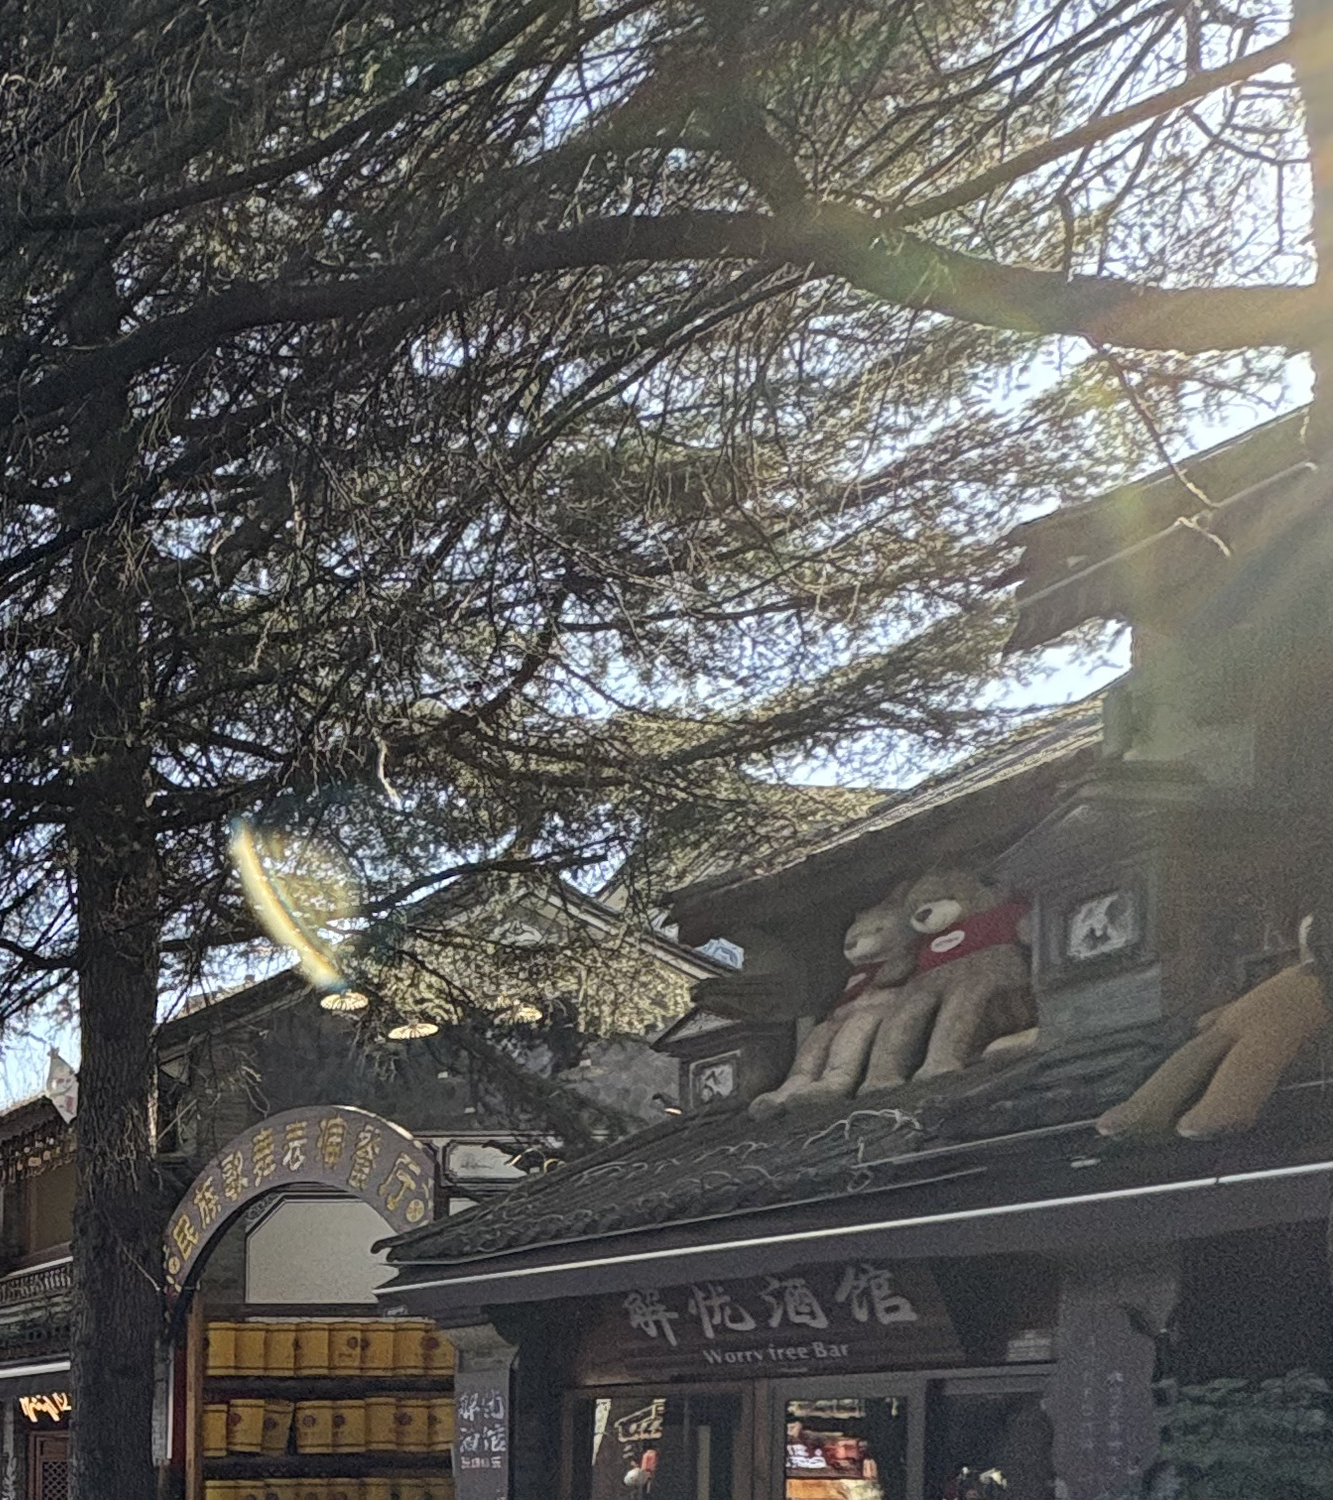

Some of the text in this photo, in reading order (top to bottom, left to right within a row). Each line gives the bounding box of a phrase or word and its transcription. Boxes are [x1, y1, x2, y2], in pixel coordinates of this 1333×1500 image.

[622, 1263, 918, 1347] 解忧酒馆
[814, 1342, 850, 1359] Bar
